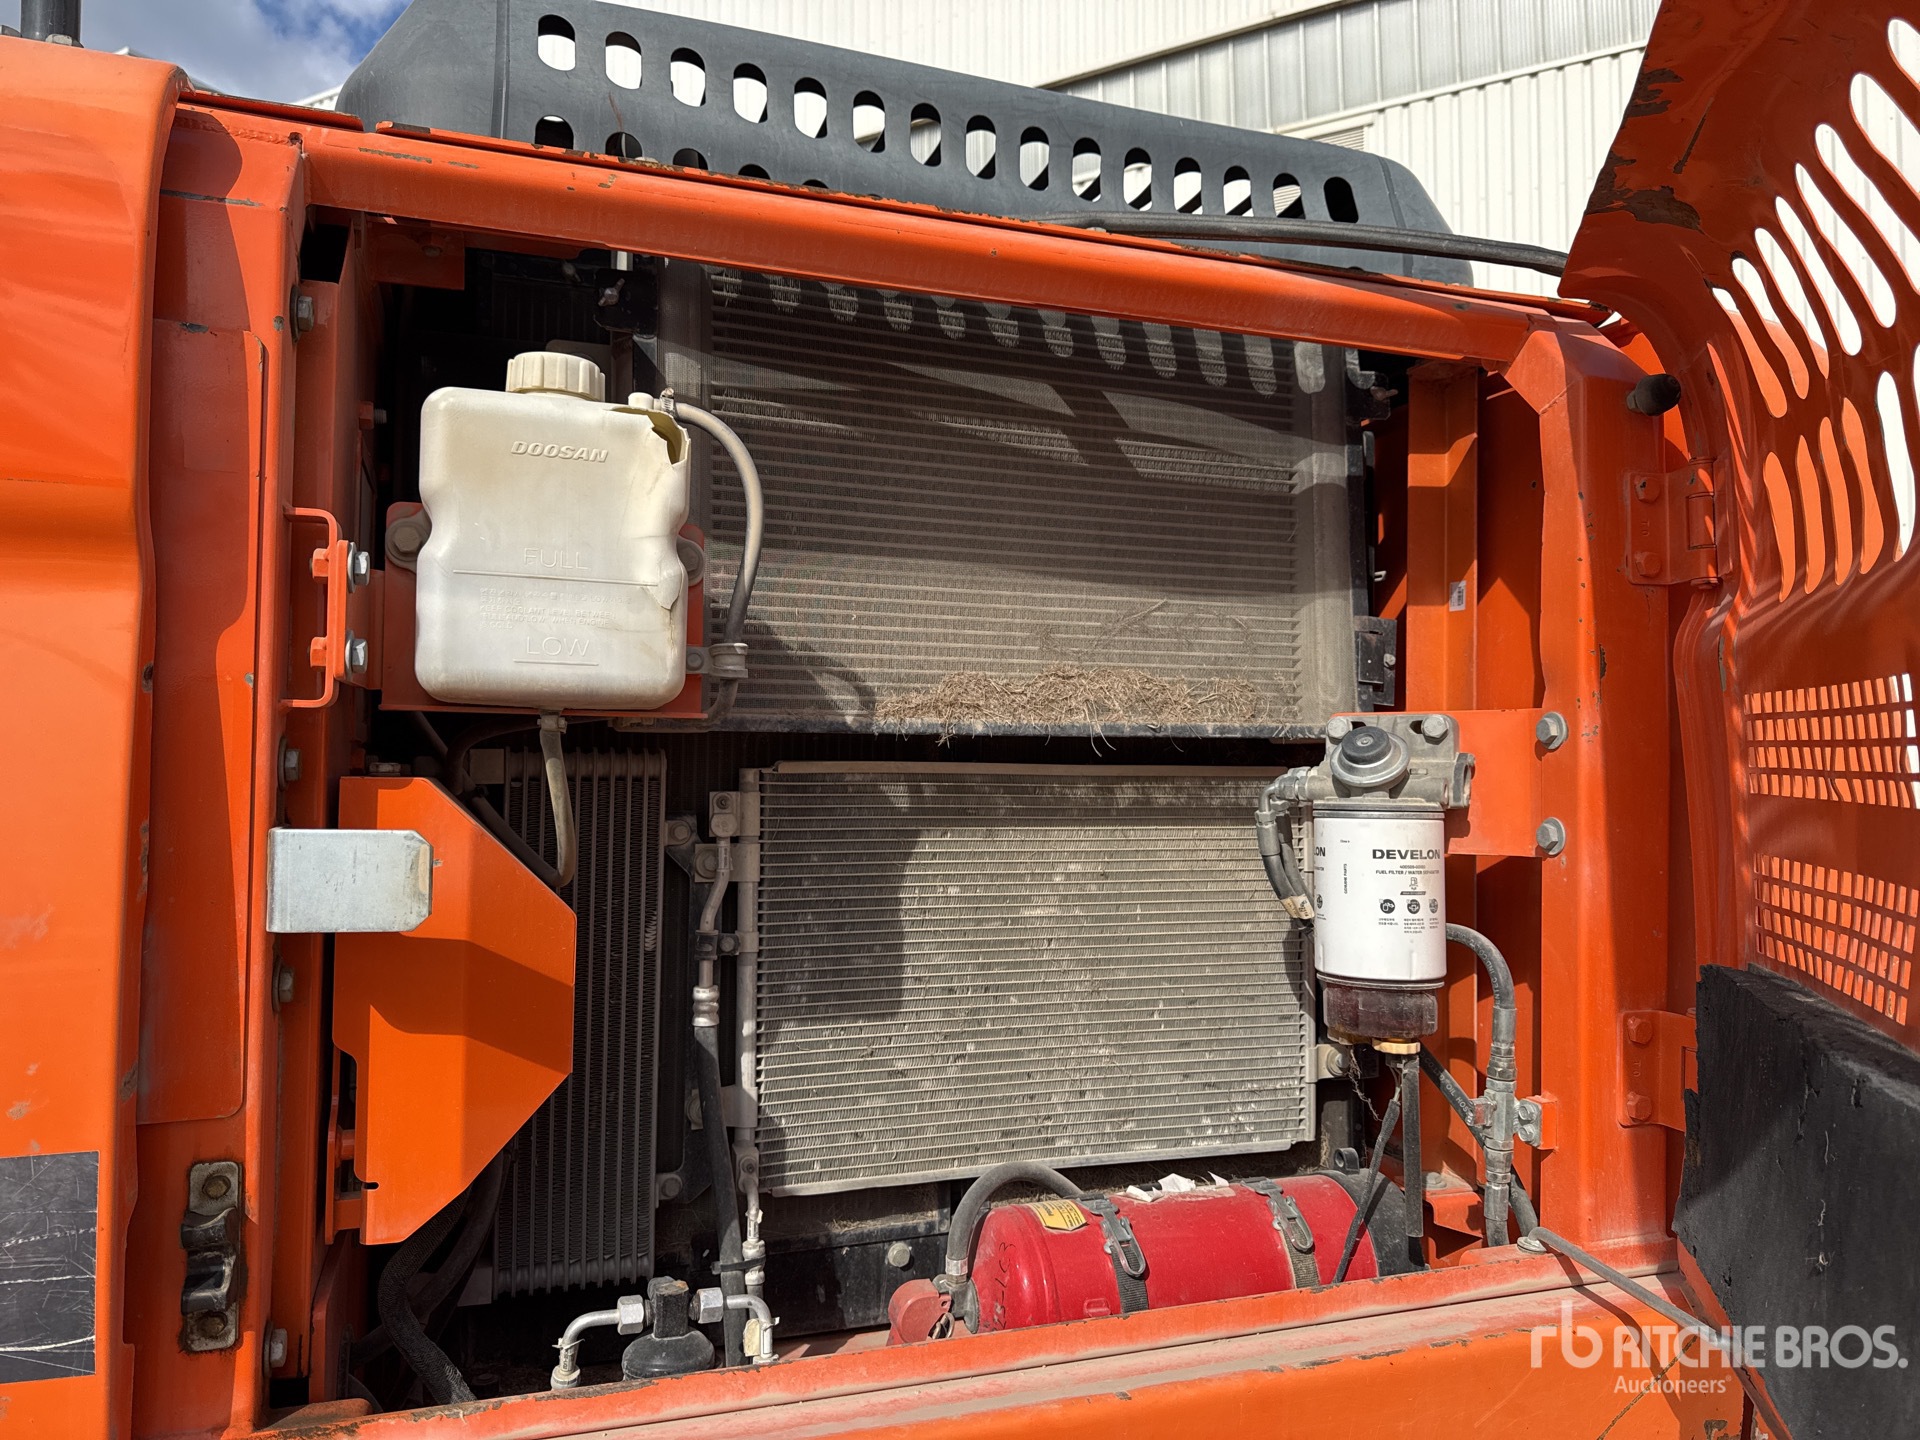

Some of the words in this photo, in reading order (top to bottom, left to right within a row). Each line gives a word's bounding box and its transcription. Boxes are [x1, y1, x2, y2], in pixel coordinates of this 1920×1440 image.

[511, 441, 608, 463] DOOSAN
[524, 548, 588, 569] FULL
[526, 637, 589, 657] LOW
[1372, 849, 1440, 860] DEVELON
